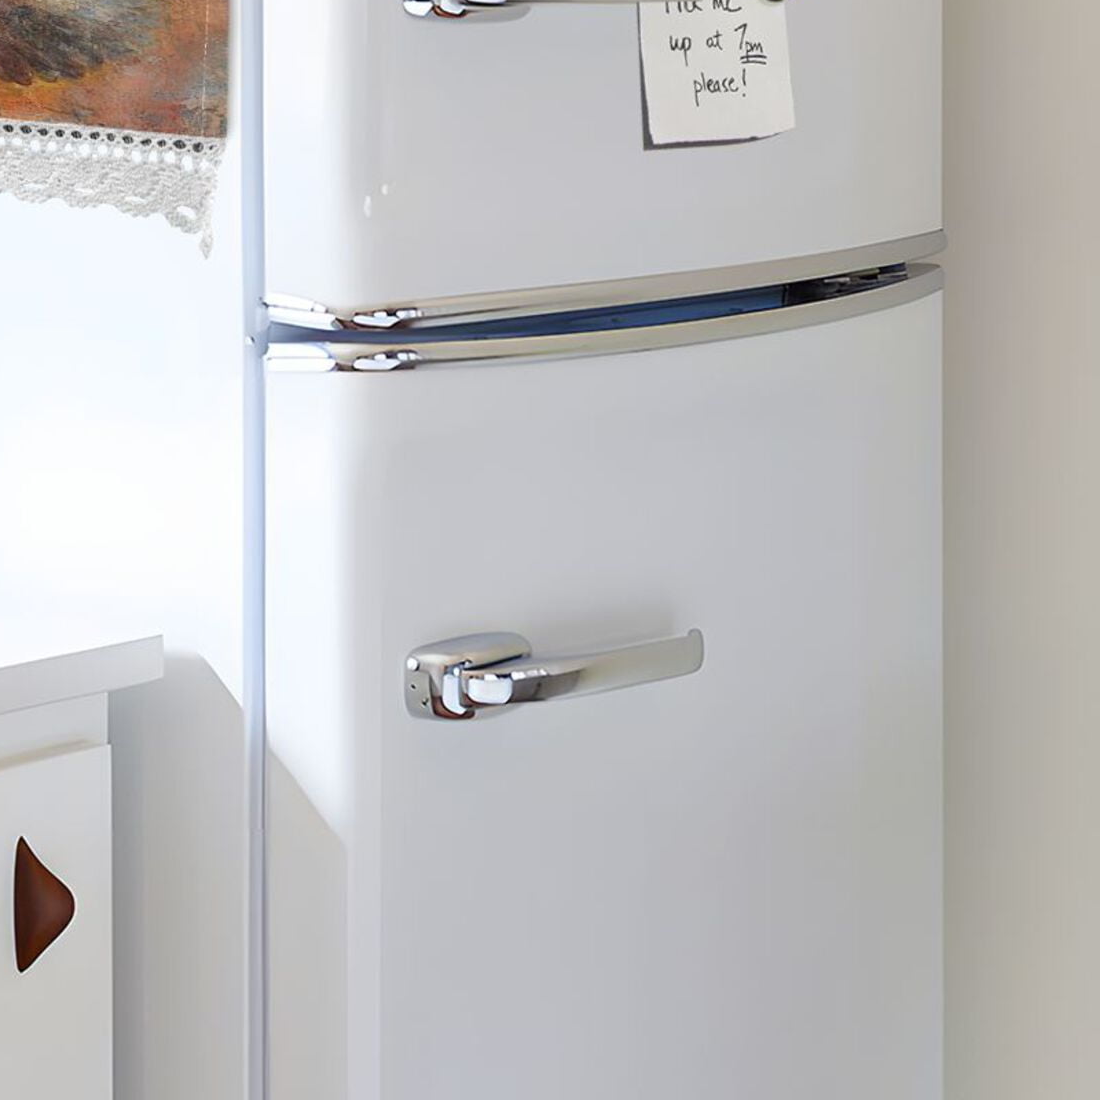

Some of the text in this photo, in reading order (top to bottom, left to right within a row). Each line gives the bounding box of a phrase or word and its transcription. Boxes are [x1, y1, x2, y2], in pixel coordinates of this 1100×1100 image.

[669, 34, 692, 67] up
[706, 29, 723, 51] at
[693, 68, 747, 107] please!
